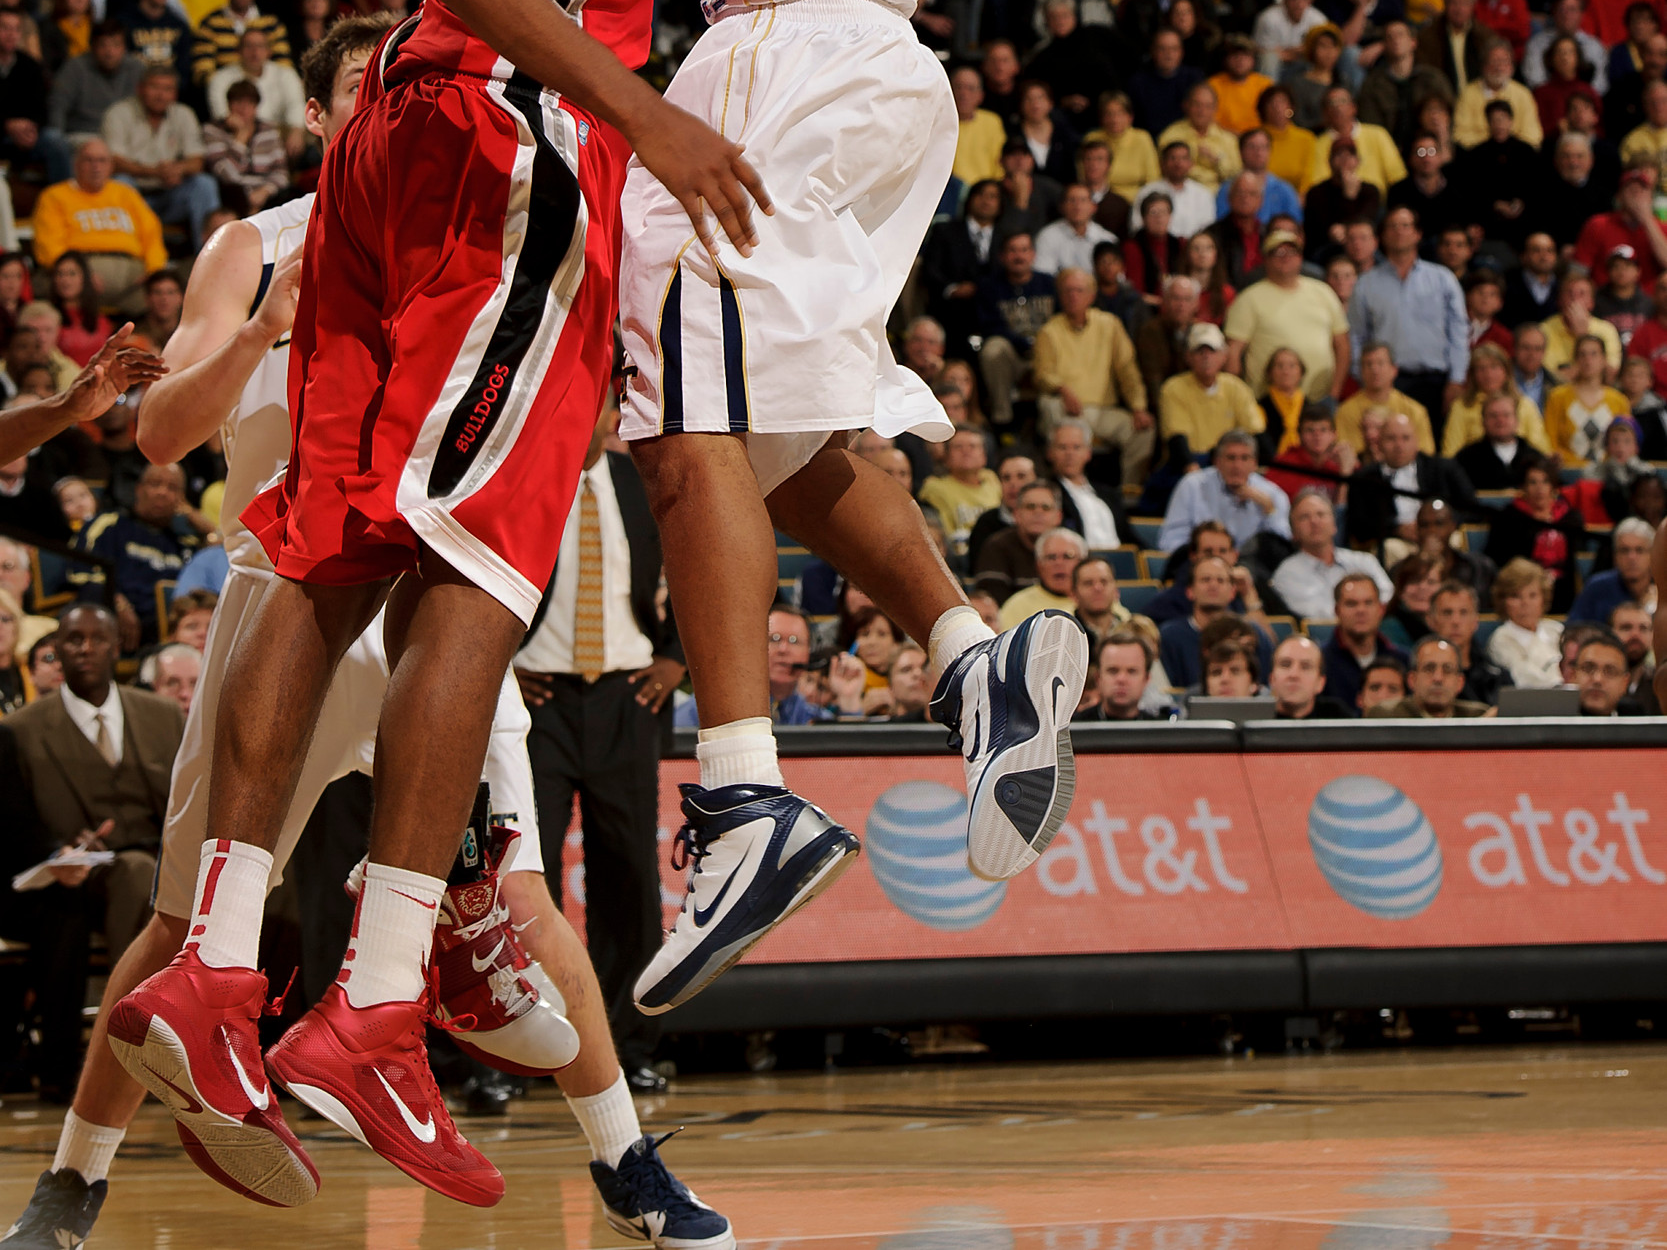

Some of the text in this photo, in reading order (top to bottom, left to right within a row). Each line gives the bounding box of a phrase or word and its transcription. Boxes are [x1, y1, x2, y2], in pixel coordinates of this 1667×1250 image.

[455, 363, 510, 454] BULLDOGS
[1036, 797, 1249, 897] at&t
[1462, 791, 1667, 889] at&t
